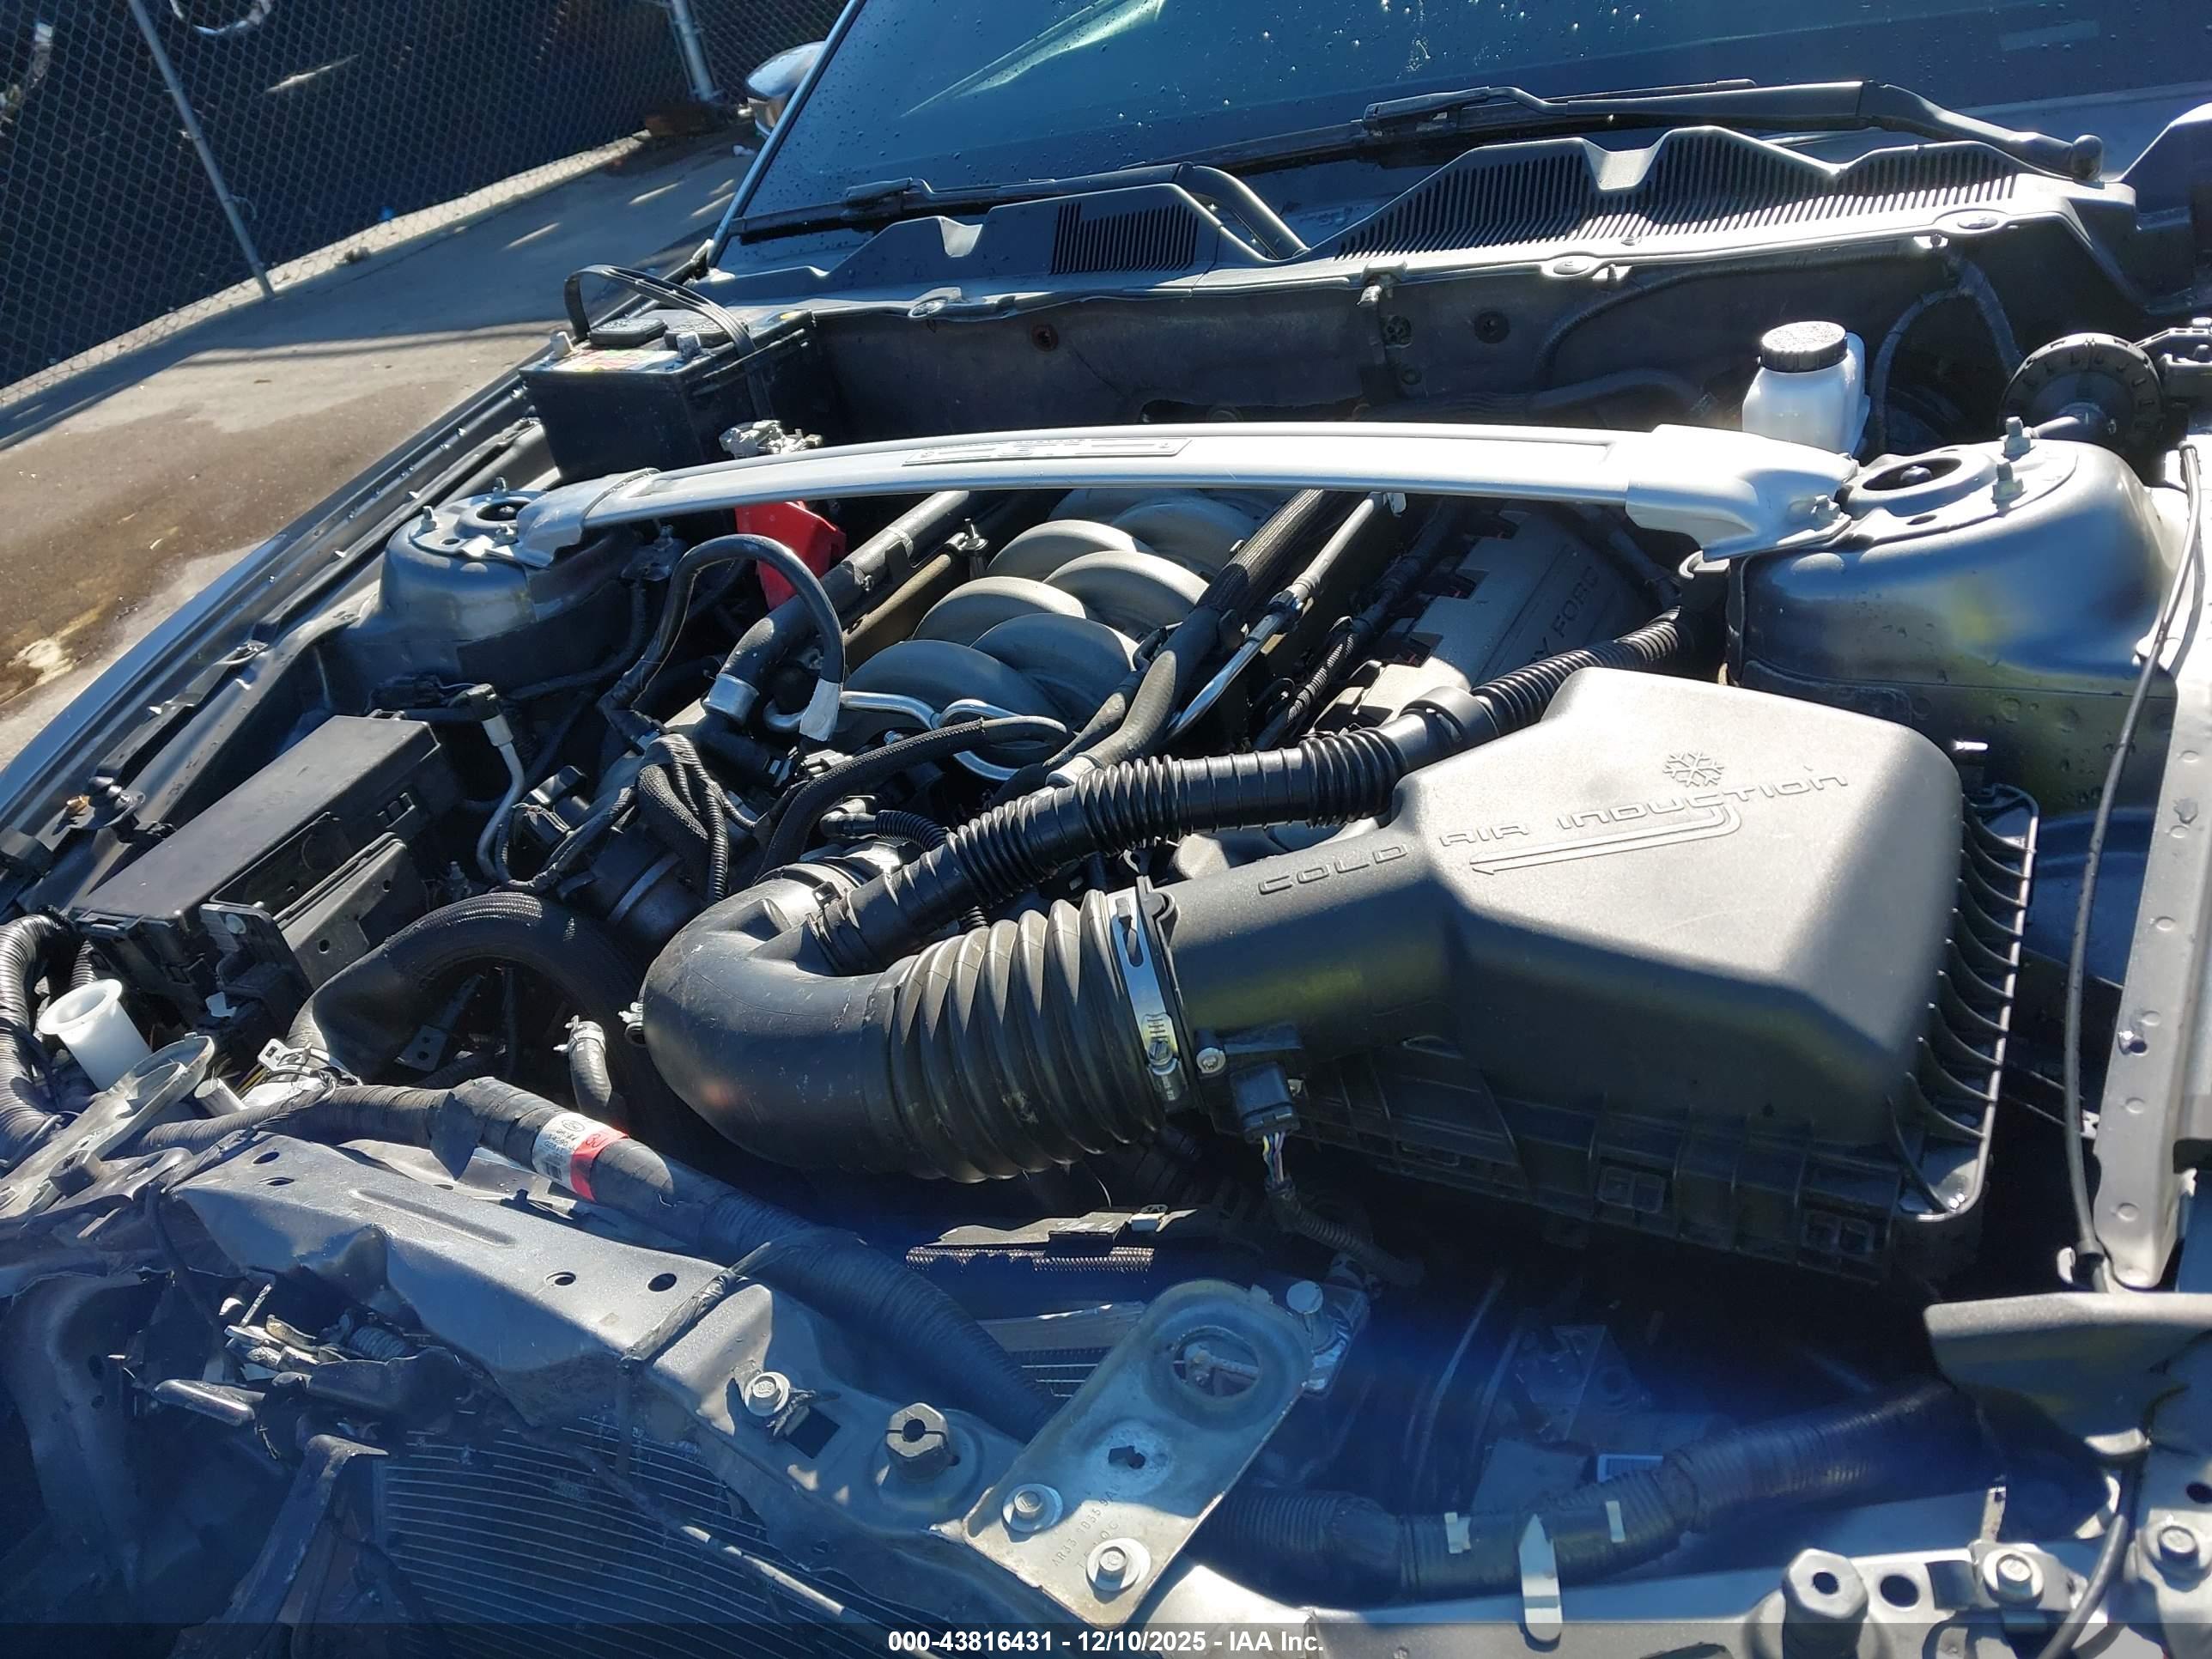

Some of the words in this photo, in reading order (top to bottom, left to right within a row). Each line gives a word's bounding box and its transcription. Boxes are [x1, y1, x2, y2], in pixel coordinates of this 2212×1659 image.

[1258, 843, 1409, 896] COLD
[1439, 823, 1530, 848] AIR
[1556, 775, 1849, 830] INDUCTION
